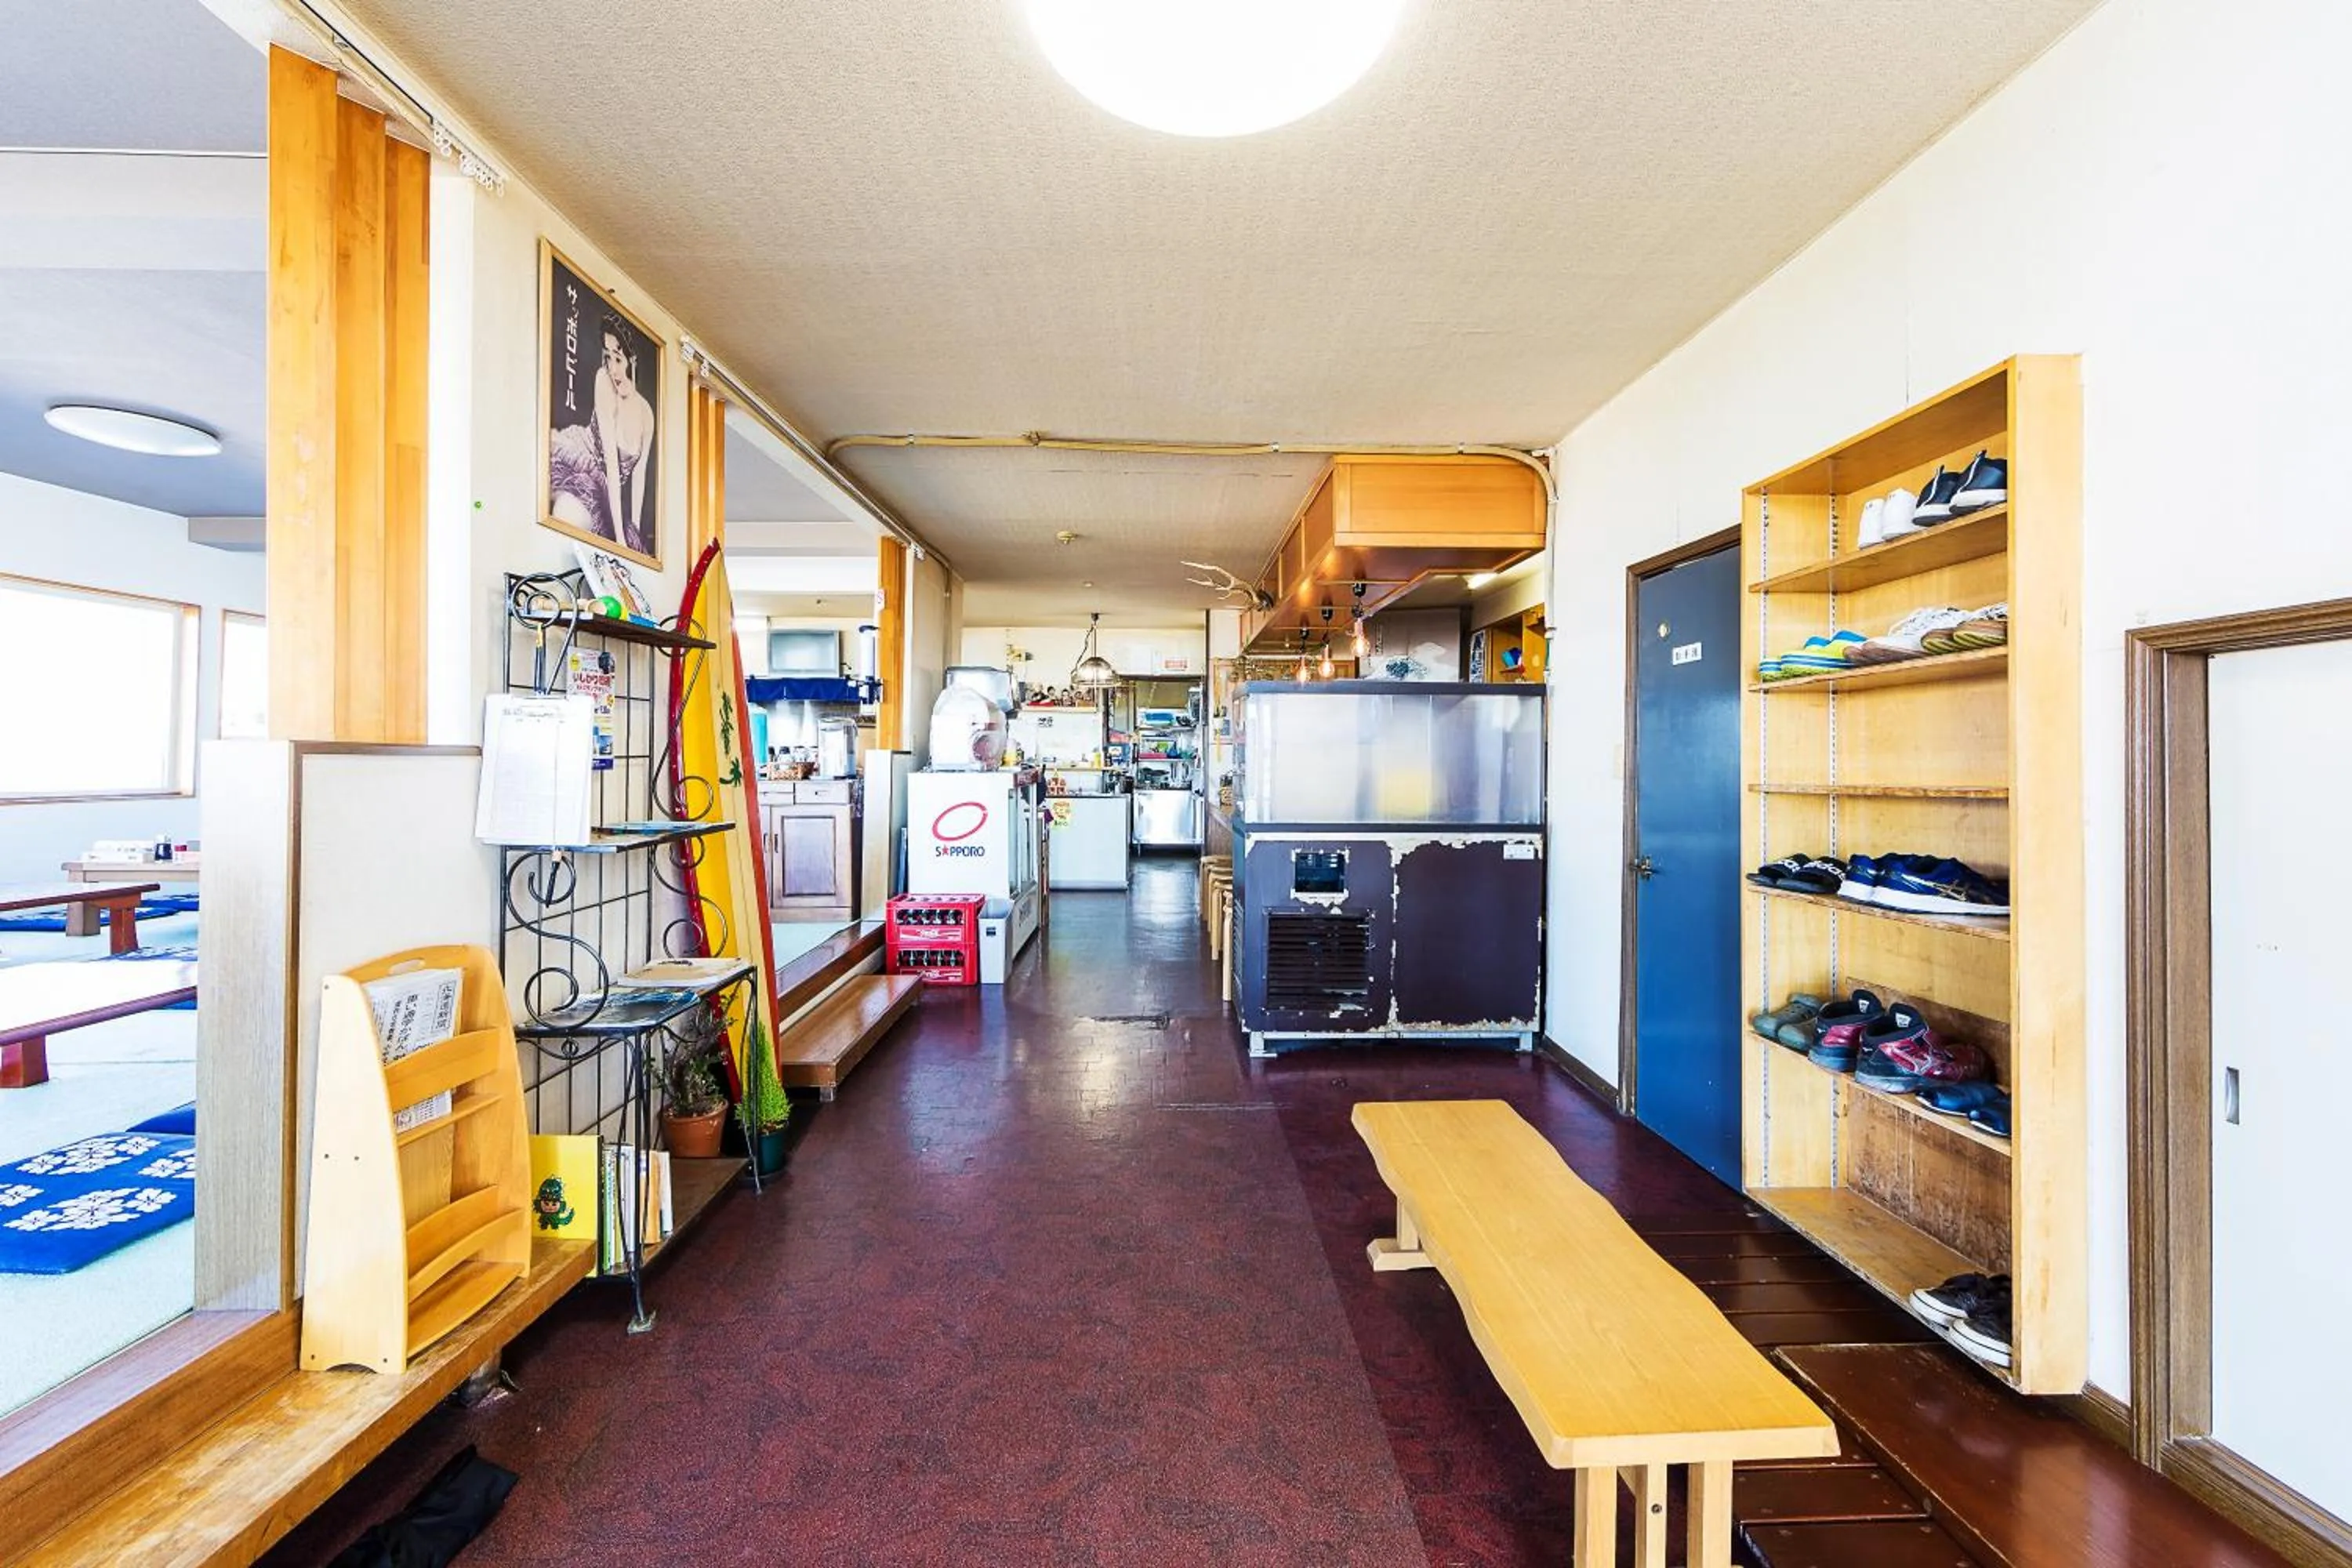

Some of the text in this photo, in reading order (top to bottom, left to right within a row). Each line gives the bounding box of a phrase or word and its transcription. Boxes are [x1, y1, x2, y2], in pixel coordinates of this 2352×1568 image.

[565, 283, 579, 412] サッポロビール
